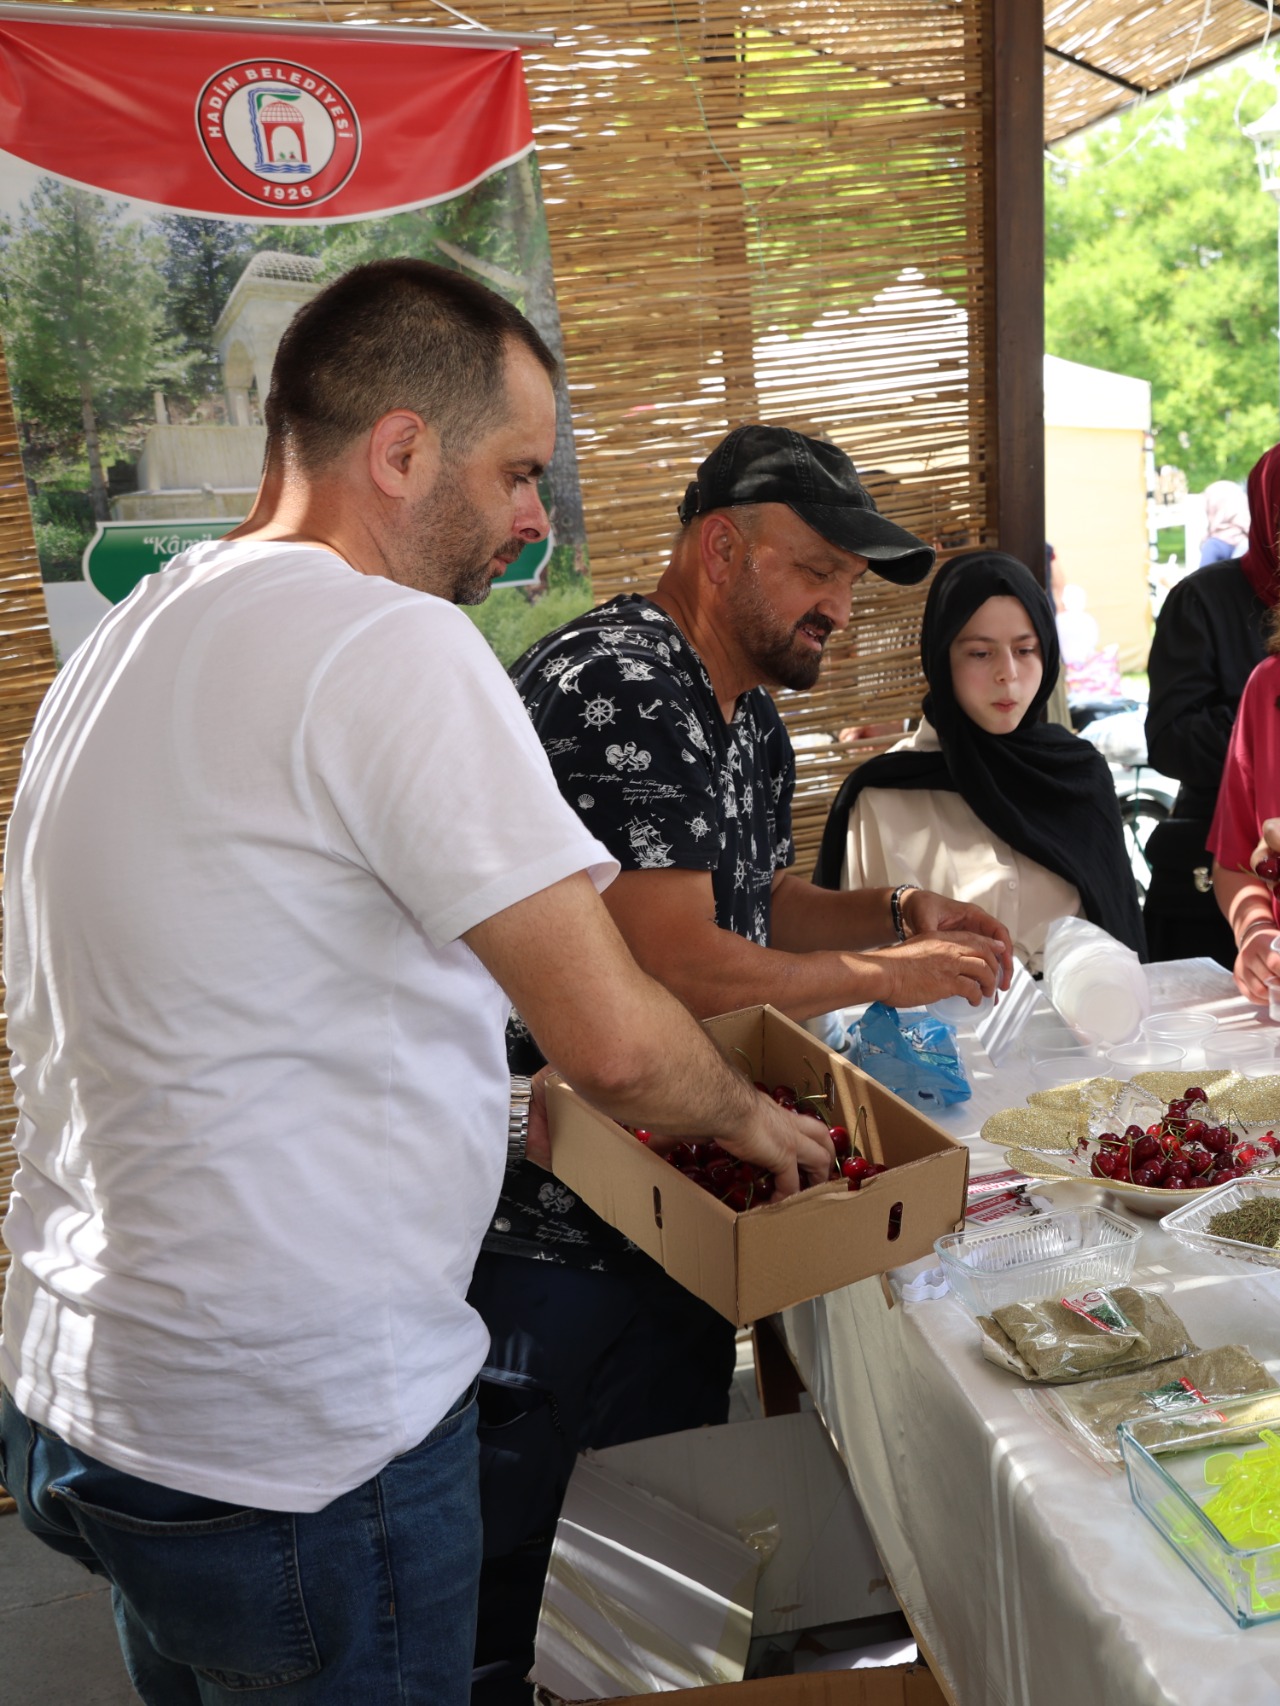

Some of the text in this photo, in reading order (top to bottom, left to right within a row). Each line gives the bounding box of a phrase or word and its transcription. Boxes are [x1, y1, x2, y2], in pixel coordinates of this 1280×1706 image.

[207, 67, 353, 138] HADİM BELEDİYESİ
[263, 185, 313, 201] 1926
